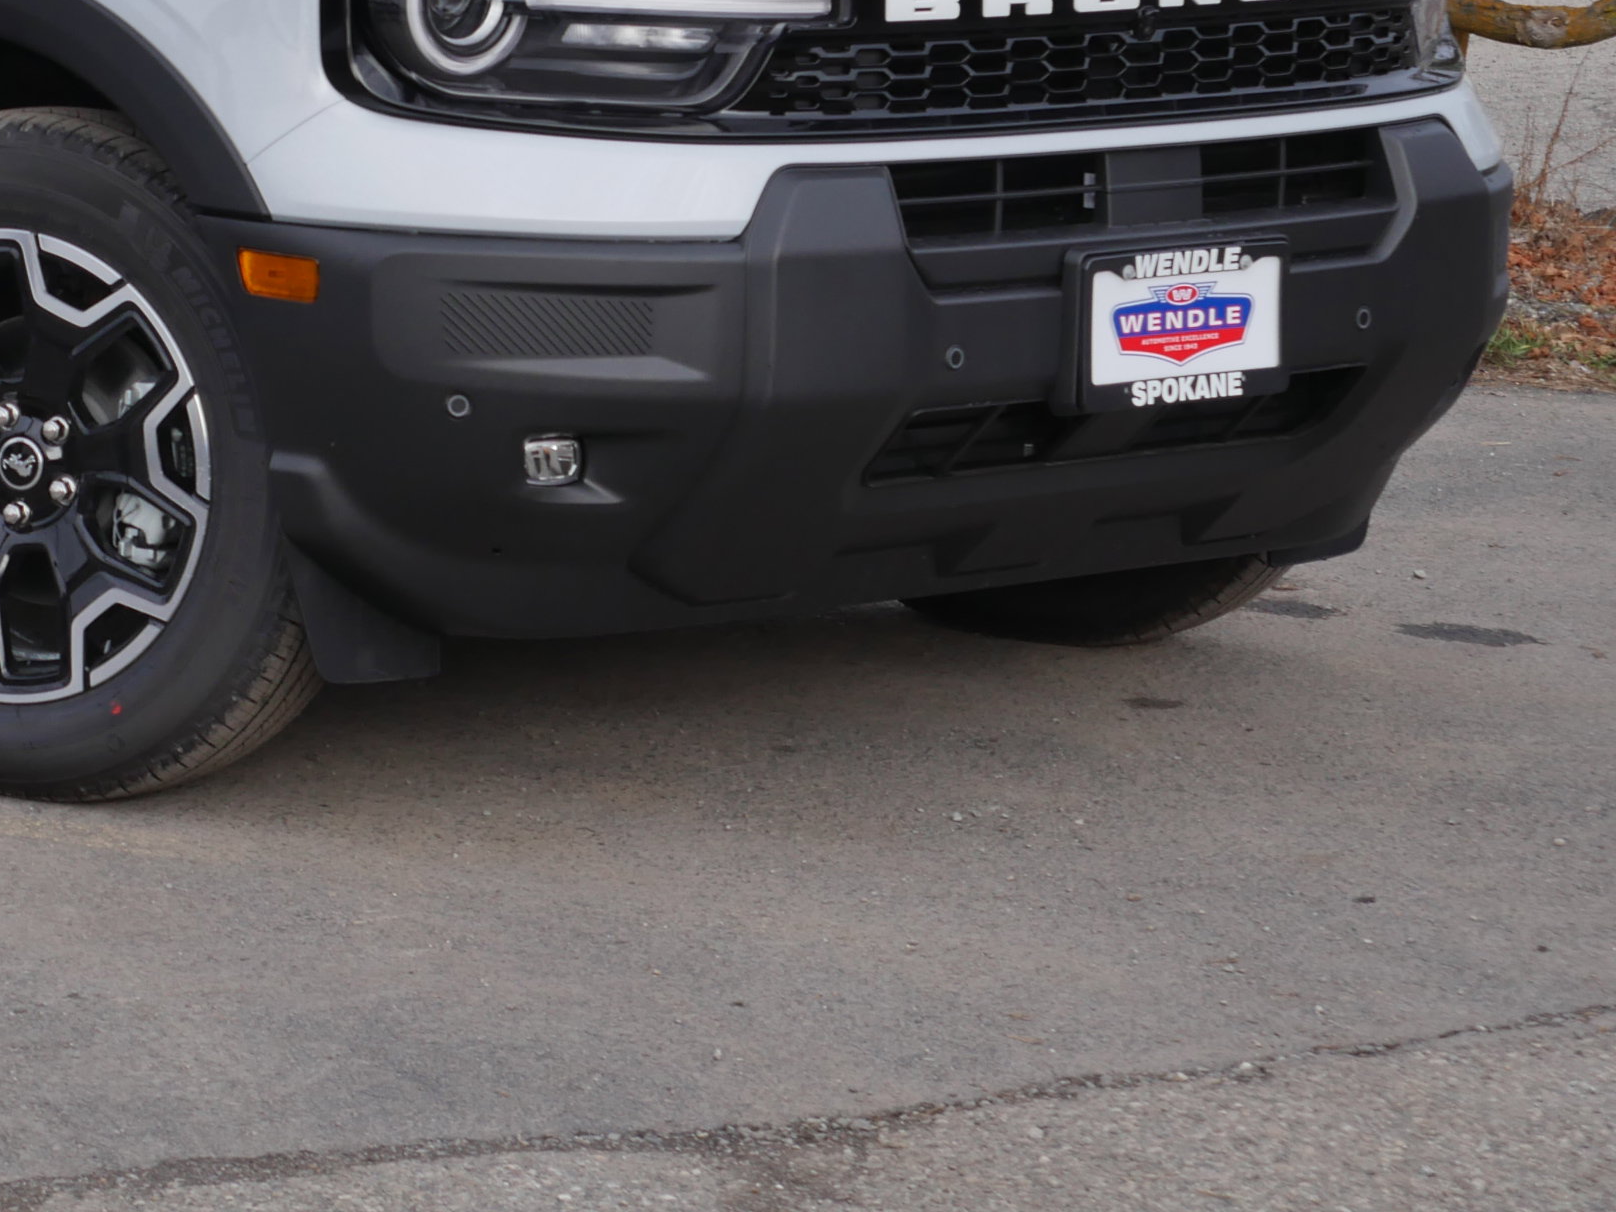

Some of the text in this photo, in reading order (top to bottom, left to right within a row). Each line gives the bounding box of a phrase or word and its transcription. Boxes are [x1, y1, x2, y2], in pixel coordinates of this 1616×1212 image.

[1134, 246, 1242, 279] WENDLE
[1119, 306, 1242, 334] WENDLE
[172, 266, 256, 432] MICHELIN
[1131, 371, 1243, 407] SPOKANE
